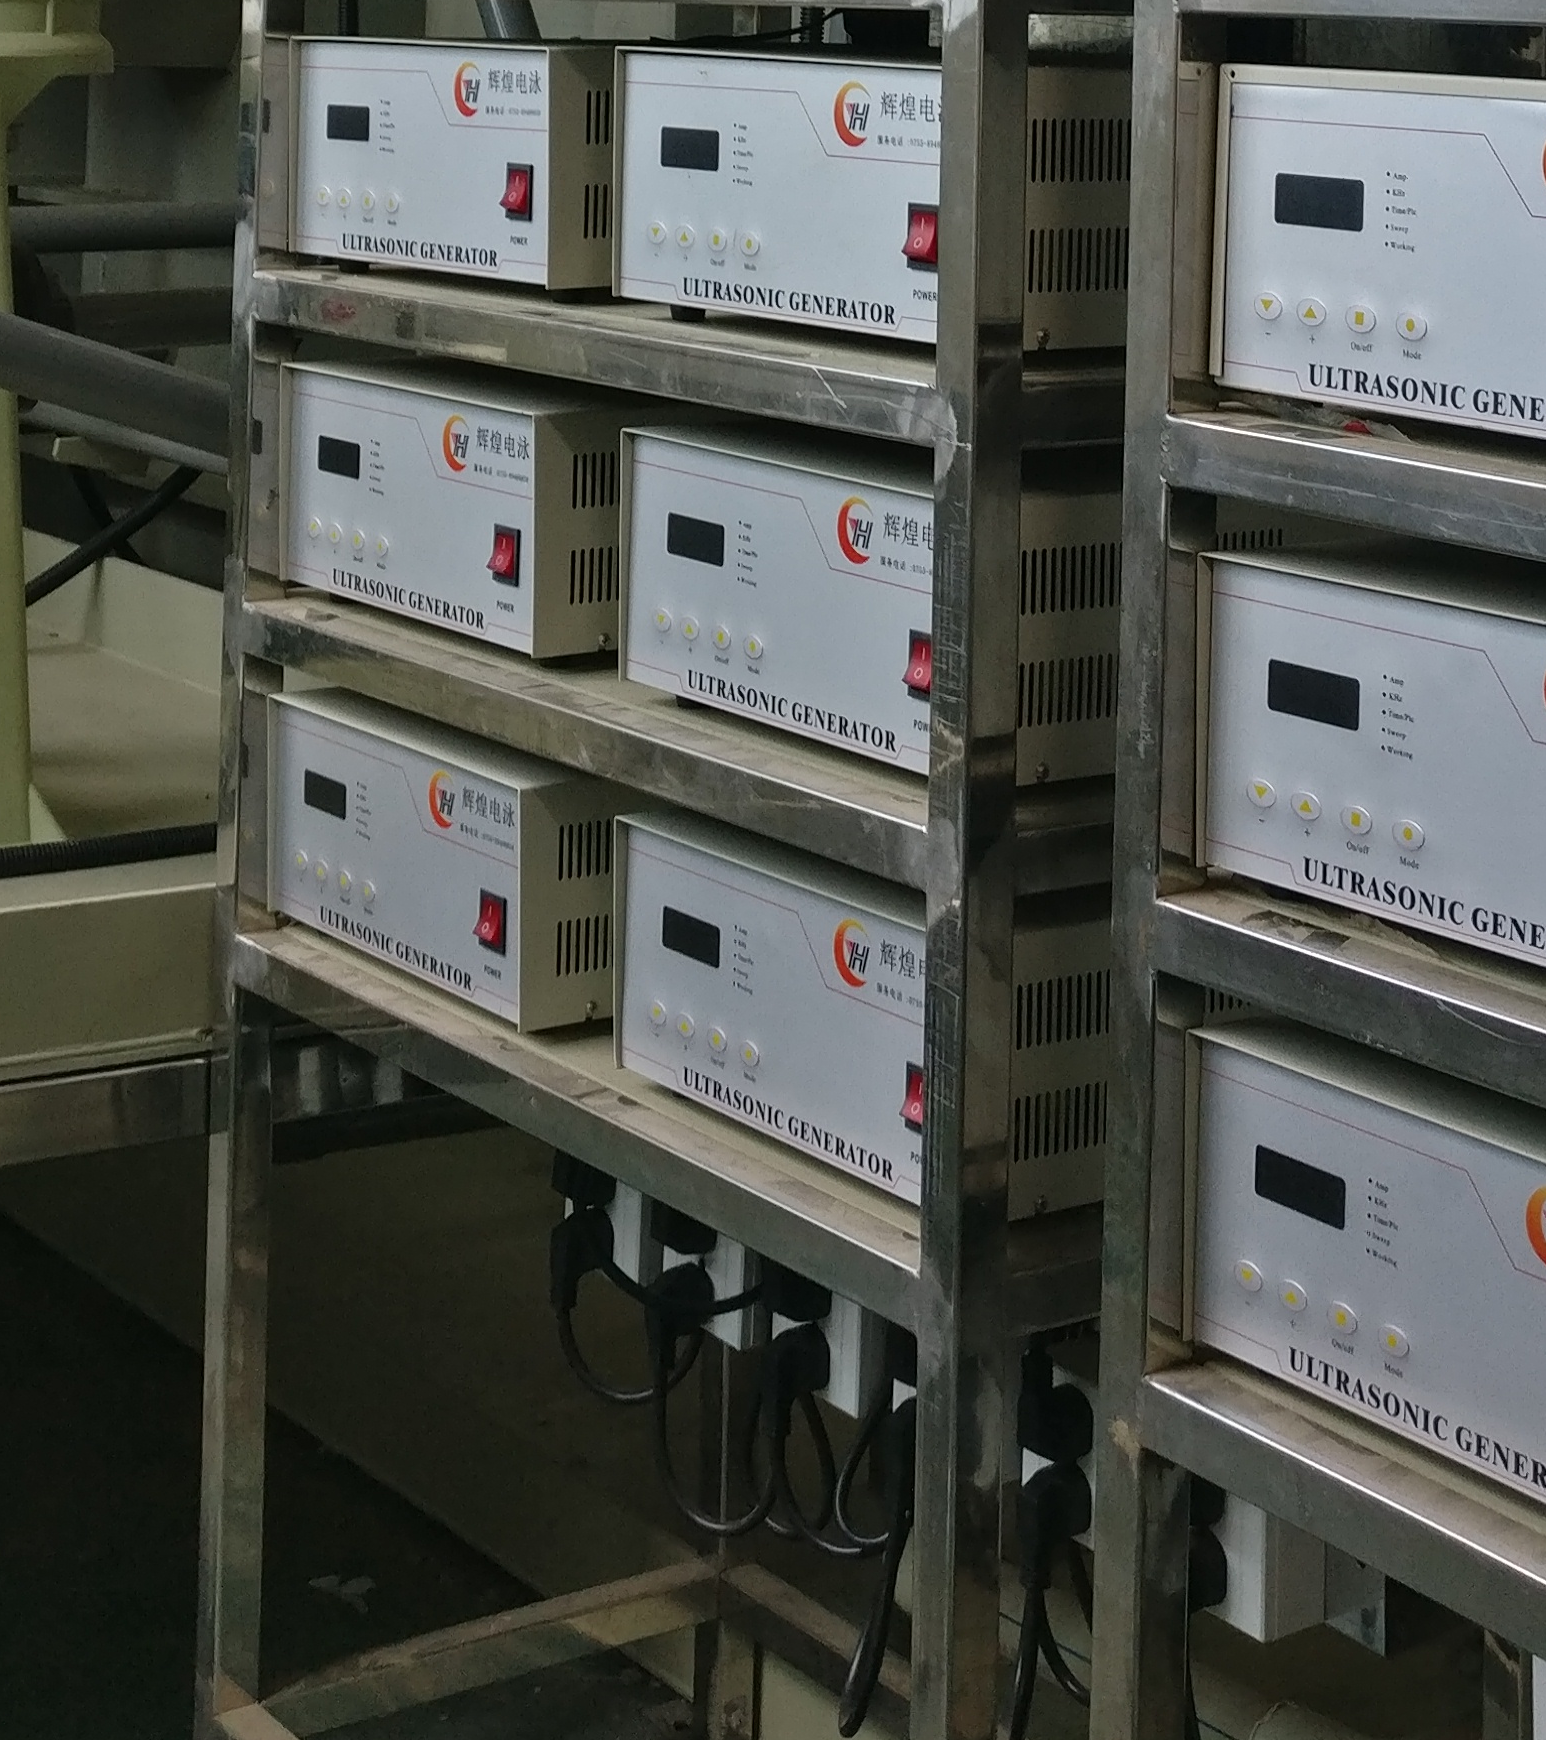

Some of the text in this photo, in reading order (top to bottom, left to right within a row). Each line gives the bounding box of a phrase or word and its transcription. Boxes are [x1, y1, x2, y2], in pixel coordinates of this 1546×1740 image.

[342, 233, 497, 266] ULTRASONIC GENERATOR
[683, 277, 895, 324] ULTRASONIC GENERATOR
[912, 289, 937, 301] POWER
[1308, 363, 1464, 410] ULTRASONIC
[883, 510, 932, 557] 辉煌电
[333, 568, 484, 628] ULTRASONIC GENERATOR
[687, 669, 896, 752] ULTRASONIC GENERATOR
[913, 719, 932, 735] POW
[1303, 857, 1463, 927] ULTRASONIC
[319, 905, 470, 990] ULTRASONIC GENERATOR
[879, 936, 924, 997] 辉煌
[683, 1066, 892, 1181] ULTRASONIC GENERATOR
[1289, 1346, 1447, 1442] ULTRASONIC
